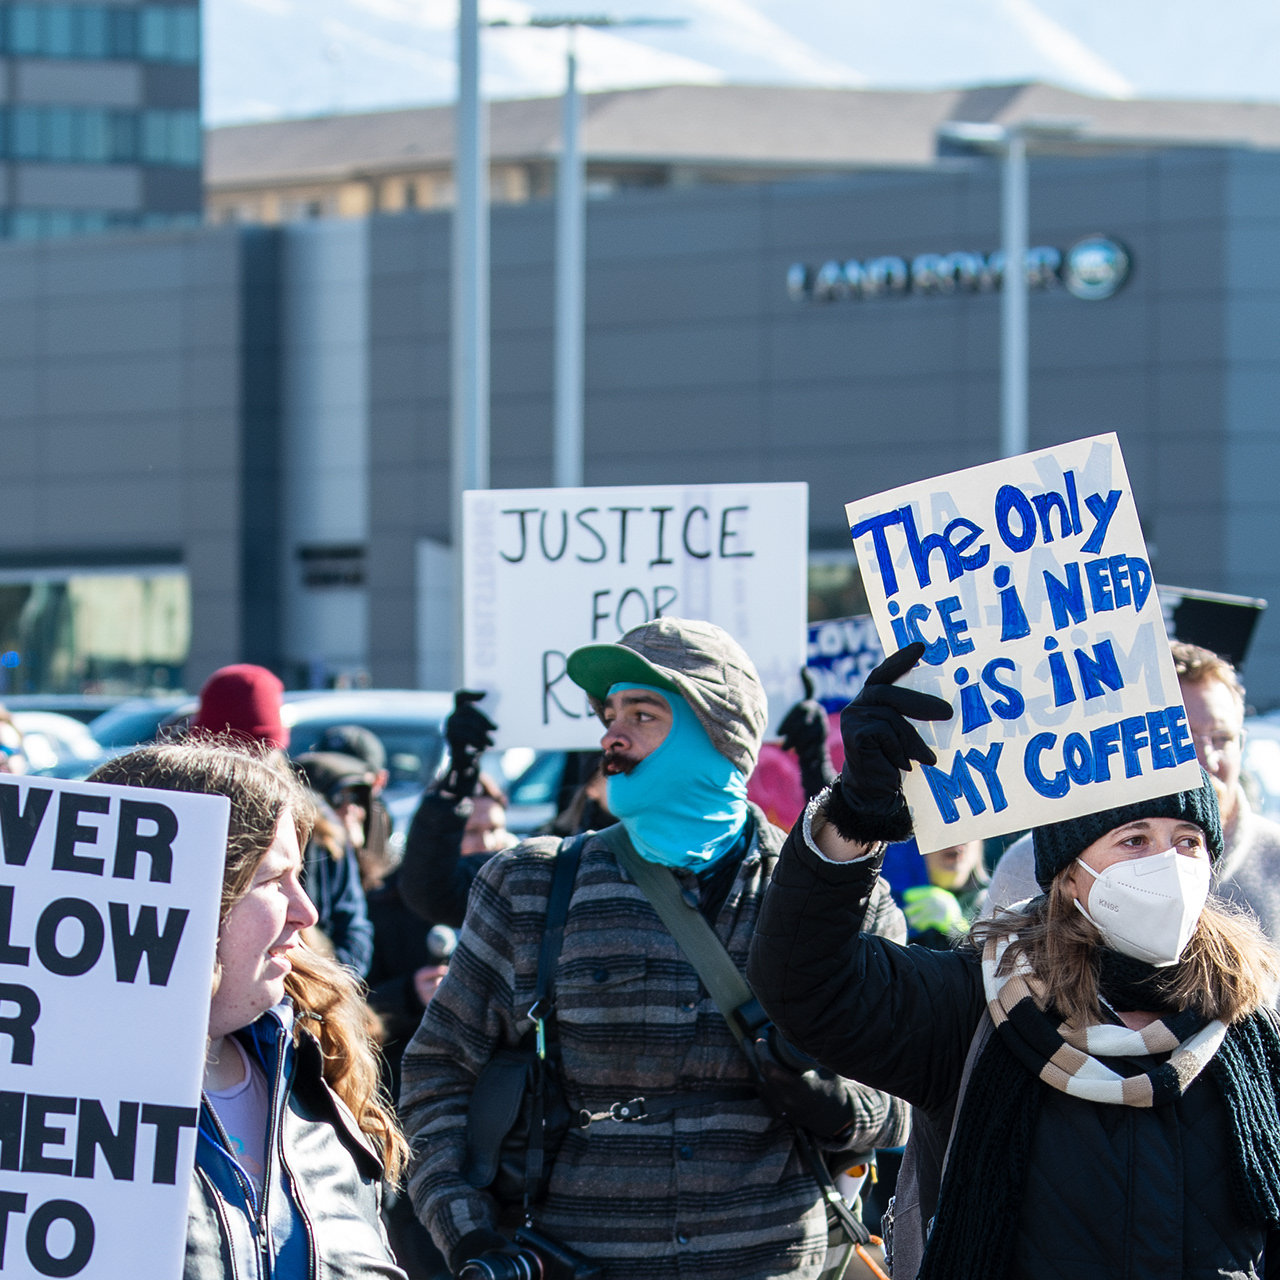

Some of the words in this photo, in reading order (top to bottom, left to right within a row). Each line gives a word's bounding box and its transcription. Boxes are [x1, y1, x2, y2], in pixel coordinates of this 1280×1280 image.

[498, 505, 756, 569] JUSTICE
[851, 505, 991, 599] The
[995, 470, 1123, 555] Only
[591, 586, 679, 640] FOR
[1043, 554, 1153, 632] NEED
[921, 741, 1009, 824] MY
[1023, 704, 1198, 799] COFFEE
[1098, 898, 1120, 913] KN95
